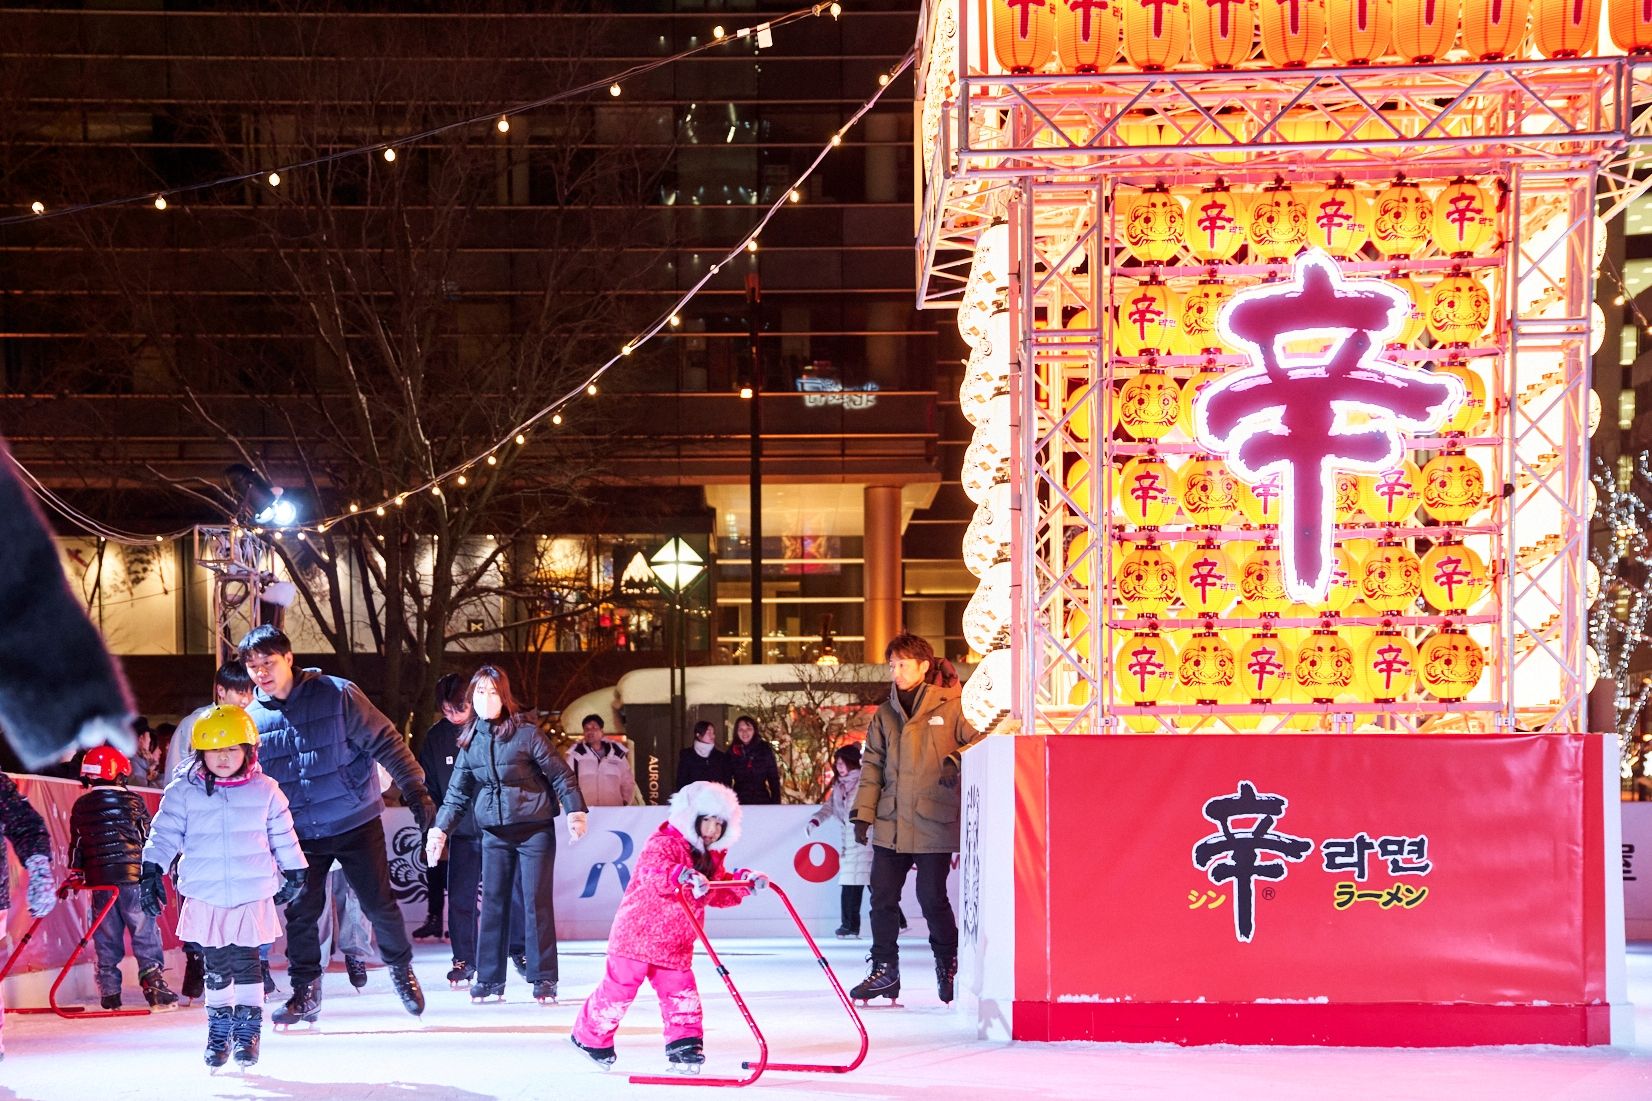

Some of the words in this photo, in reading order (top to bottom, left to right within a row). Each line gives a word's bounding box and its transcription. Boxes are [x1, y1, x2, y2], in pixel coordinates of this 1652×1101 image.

[1197, 199, 1234, 249] 辛
[1315, 196, 1353, 246] 辛
[1445, 191, 1484, 241] 辛
[1128, 292, 1164, 341] 辛
[1198, 251, 1462, 600] 辛
[1130, 470, 1167, 518] 辛
[1375, 467, 1412, 514] 辛
[1188, 557, 1226, 605] 辛
[1433, 555, 1472, 602] 辛
[1128, 645, 1164, 693] 辛
[1247, 646, 1284, 691] 辛
[1373, 643, 1410, 690] 辛
[1192, 780, 1315, 943] 辛
[1321, 832, 1432, 881] 라면
[1187, 889, 1226, 910] シン
[1333, 882, 1429, 911] ラーメン
